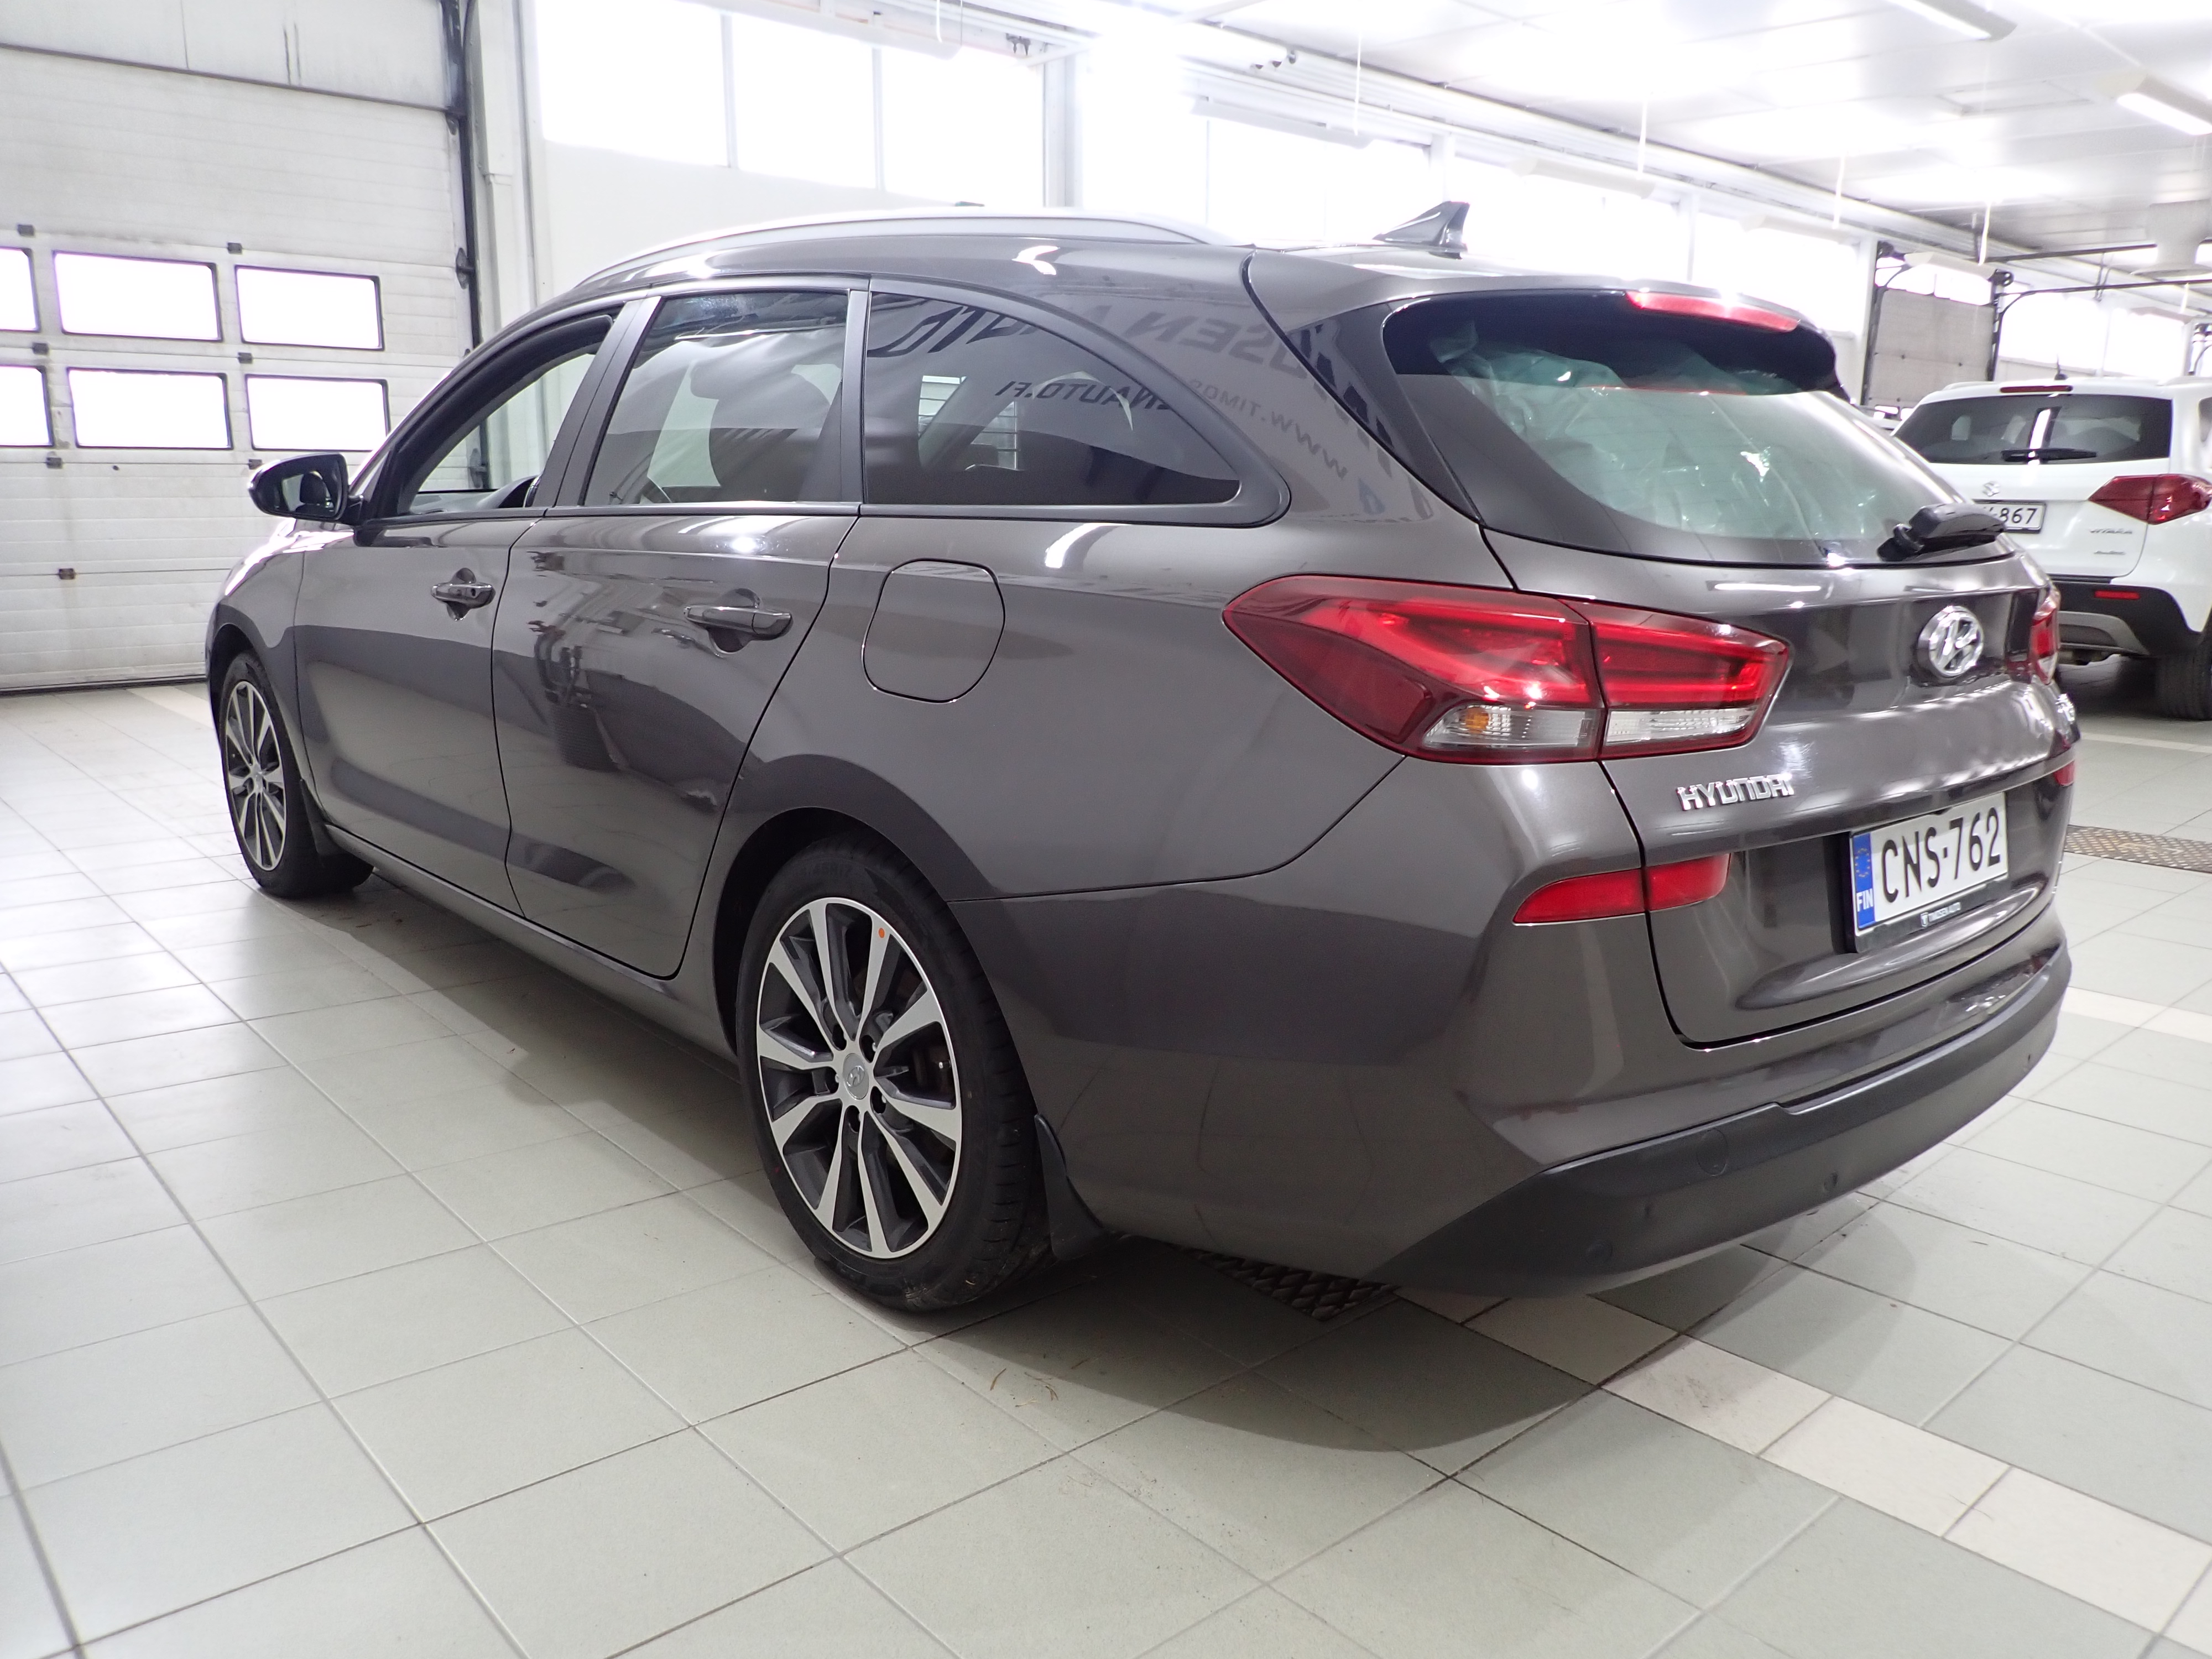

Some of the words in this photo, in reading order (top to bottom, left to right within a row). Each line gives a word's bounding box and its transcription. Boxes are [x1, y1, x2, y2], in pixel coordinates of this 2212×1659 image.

[1677, 773, 1795, 811] HYUNDAI
[1881, 807, 2001, 903] CNS-762
[1856, 888, 1874, 912] FIN
